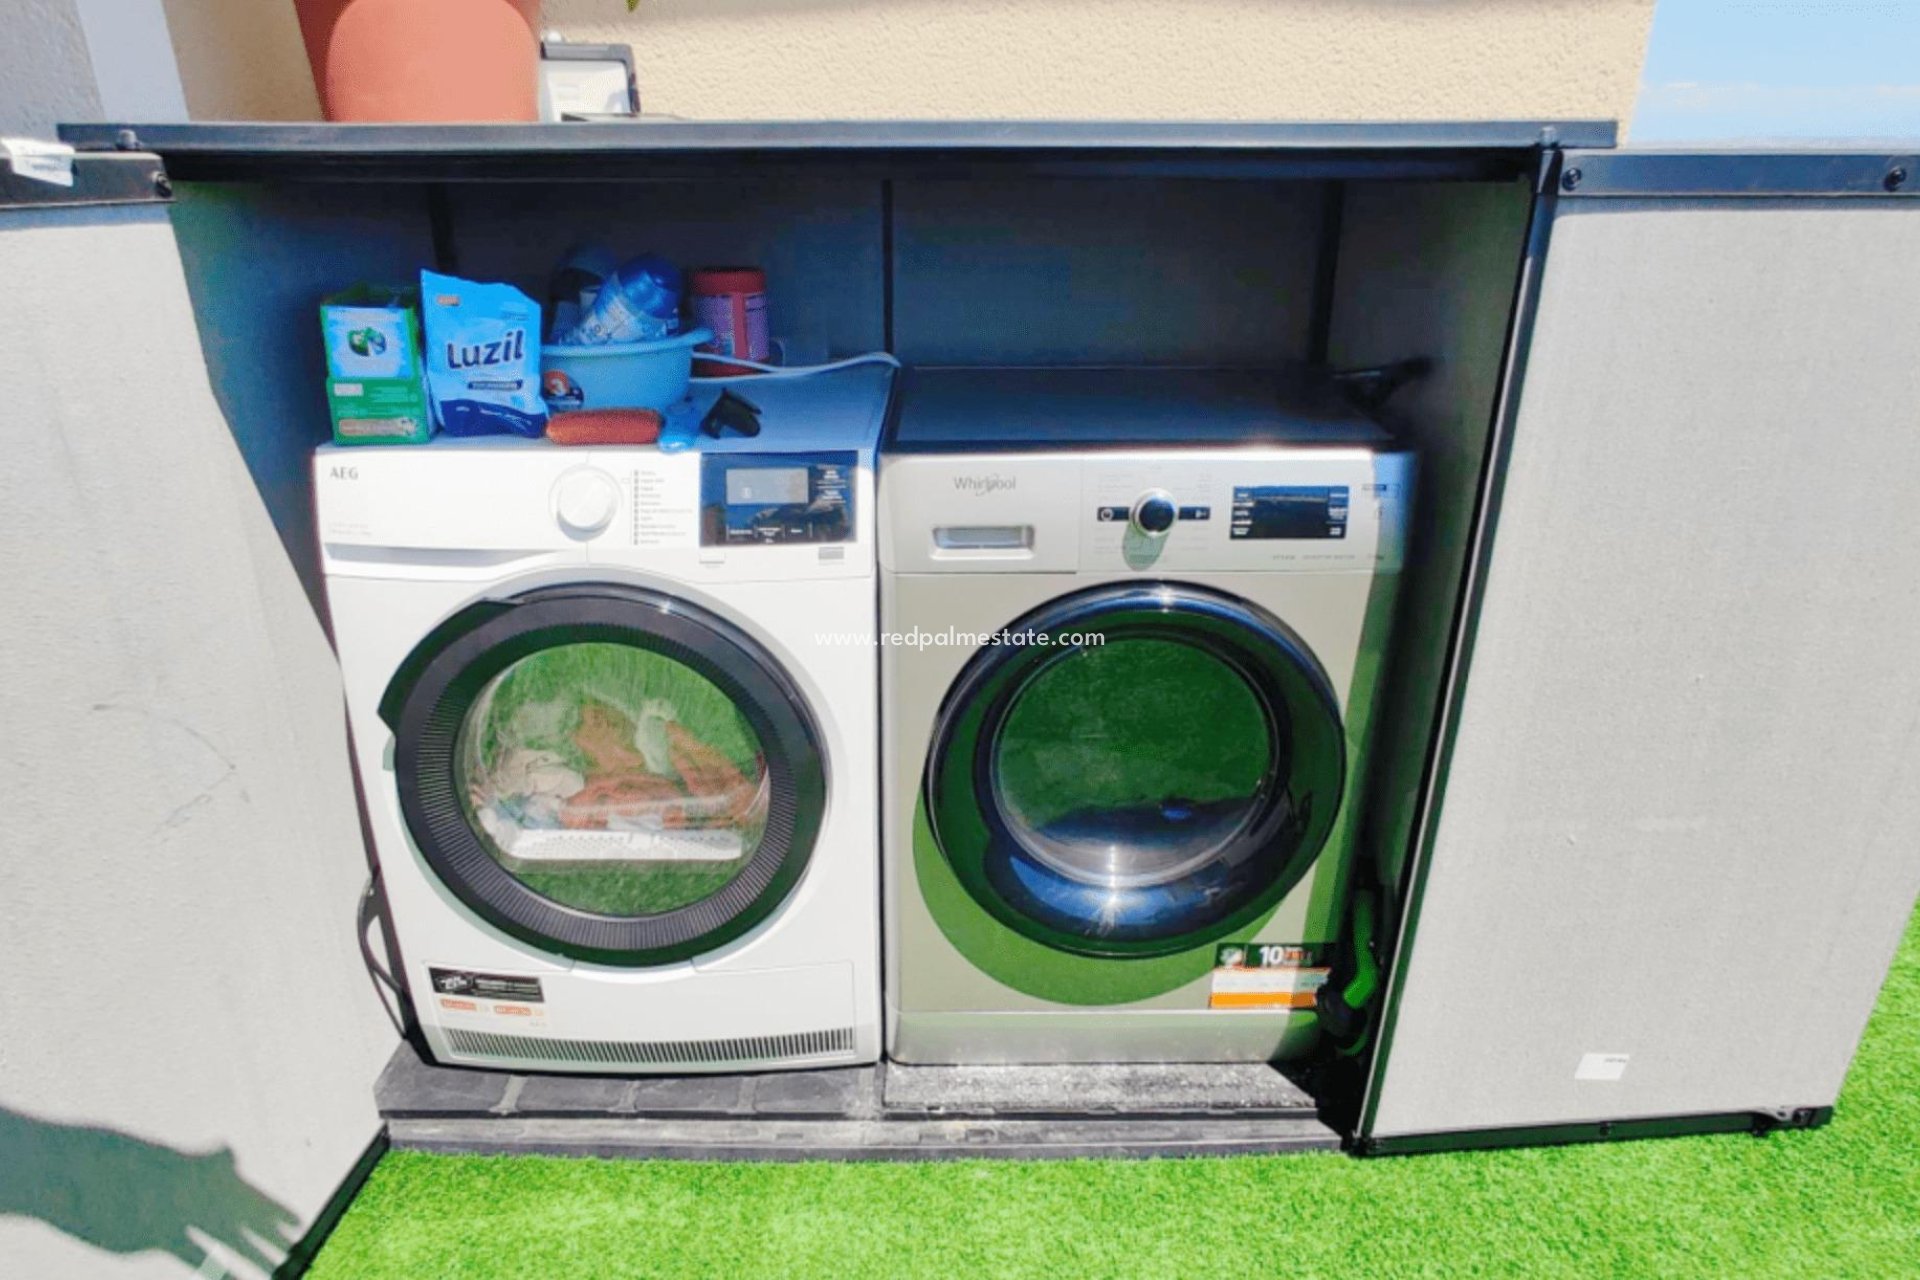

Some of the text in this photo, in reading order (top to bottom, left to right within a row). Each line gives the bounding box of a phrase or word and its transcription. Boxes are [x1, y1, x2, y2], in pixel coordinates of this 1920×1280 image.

[447, 329, 524, 369] Luzil
[329, 466, 359, 480] AEG
[953, 474, 1017, 496] Whirlpool
[1259, 946, 1285, 966] 10
